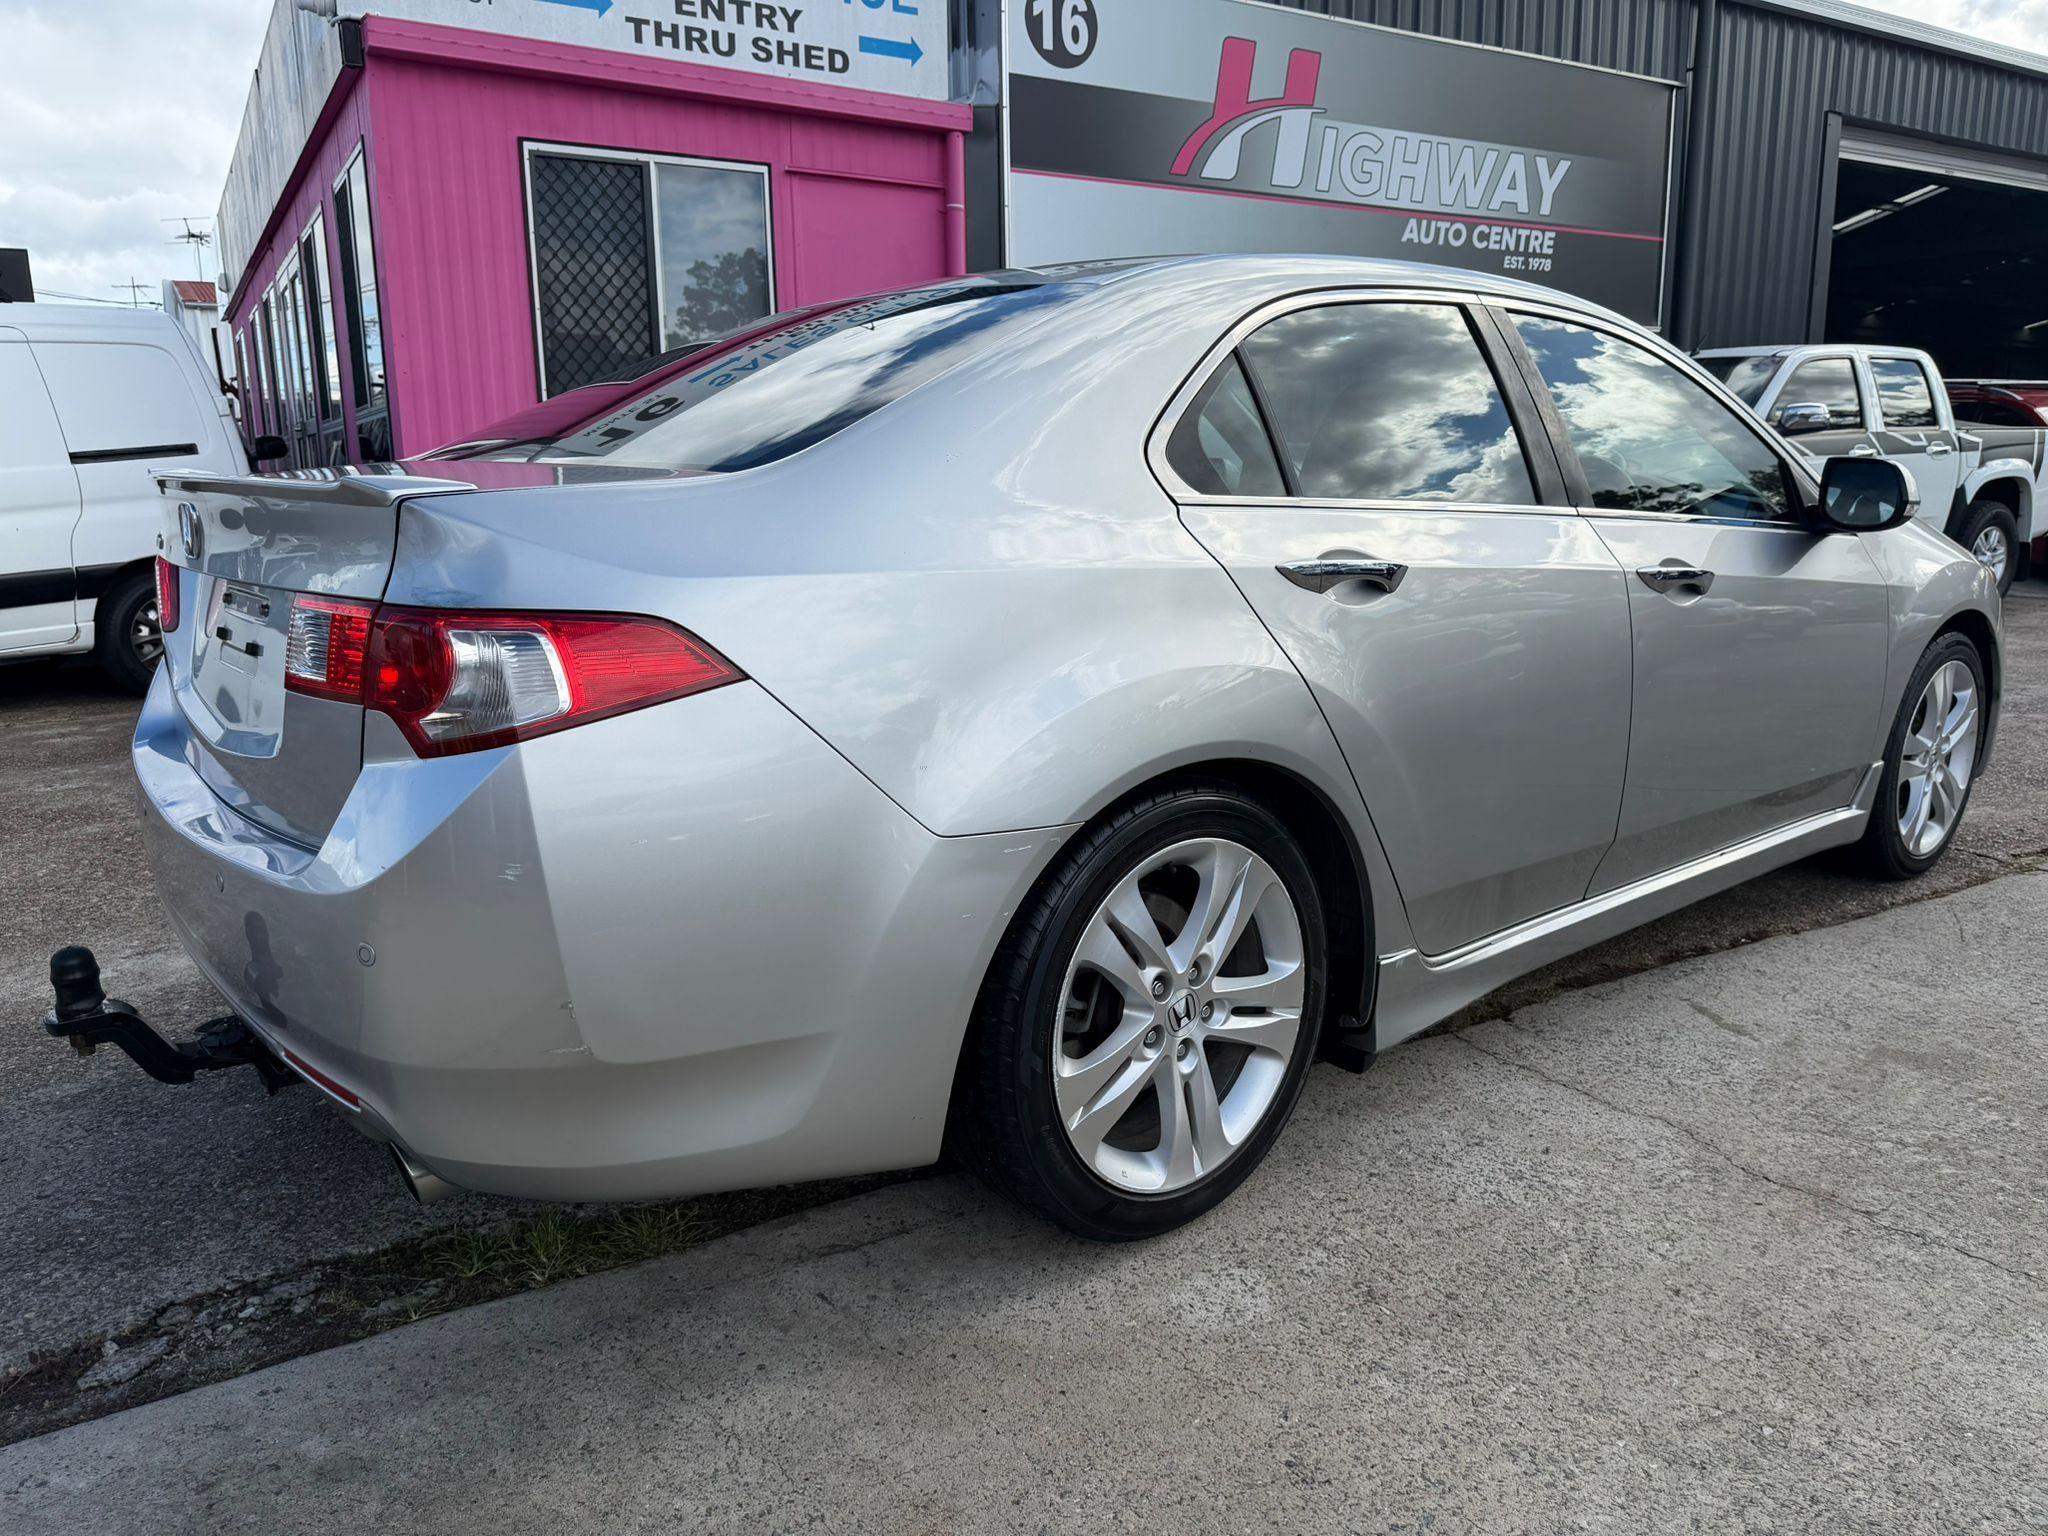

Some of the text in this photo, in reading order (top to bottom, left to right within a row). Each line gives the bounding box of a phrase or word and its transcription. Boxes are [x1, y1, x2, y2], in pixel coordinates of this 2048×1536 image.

[674, 0, 803, 33] ENTRY
[1032, 0, 1089, 56] 16
[624, 16, 850, 74] THRU SHED
[1401, 218, 1556, 255] AUTO CENTRE
[1503, 256, 1552, 272] EST. 1978
